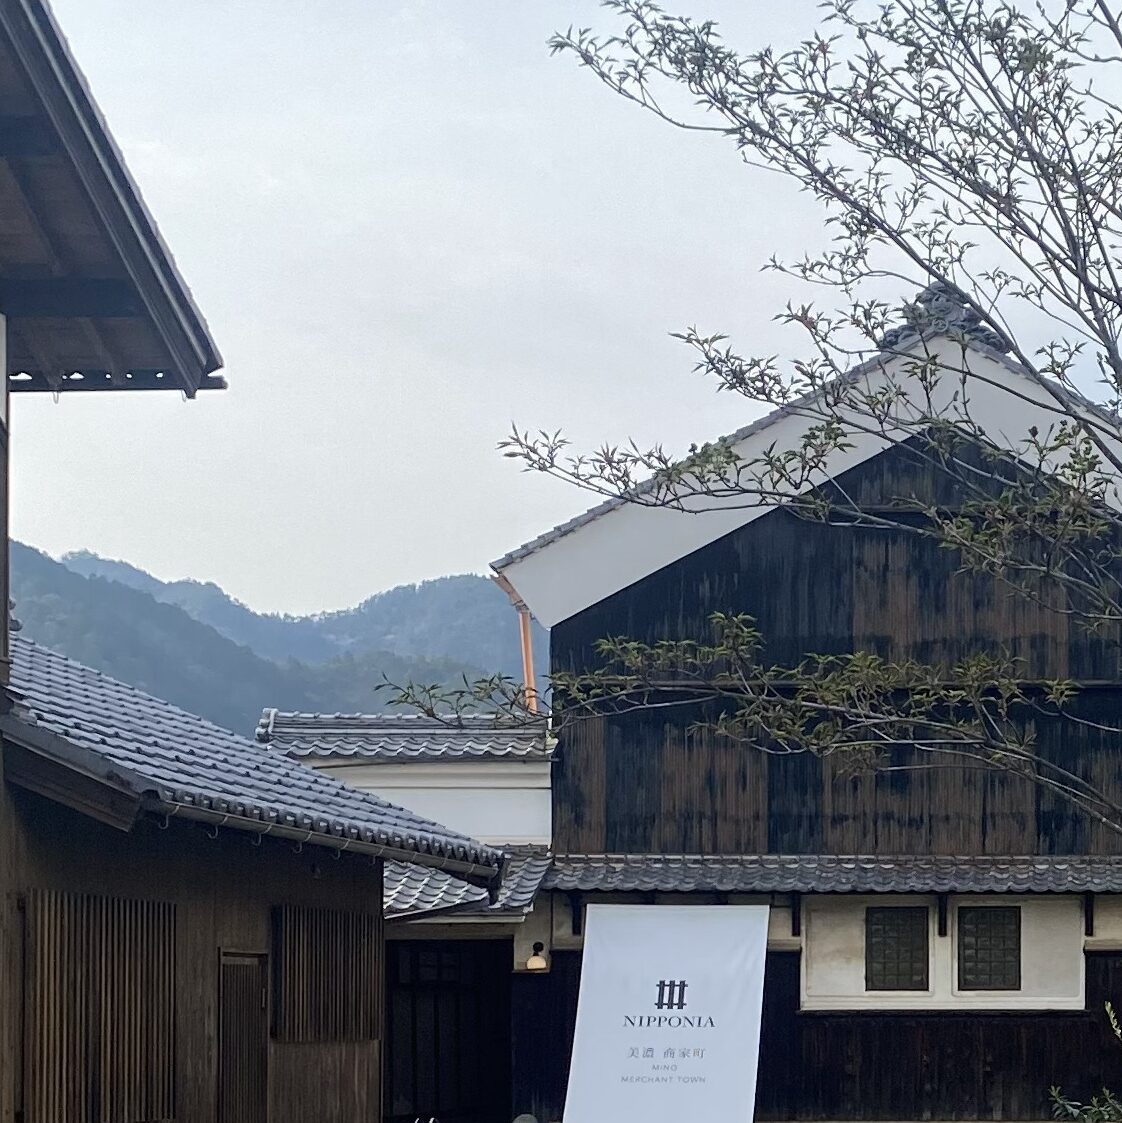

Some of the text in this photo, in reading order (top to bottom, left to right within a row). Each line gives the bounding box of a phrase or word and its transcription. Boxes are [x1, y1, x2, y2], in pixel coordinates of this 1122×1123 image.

[623, 1015, 716, 1028] NIPPONIA
[663, 1047, 706, 1059] 商家町
[652, 1064, 678, 1072] MINO
